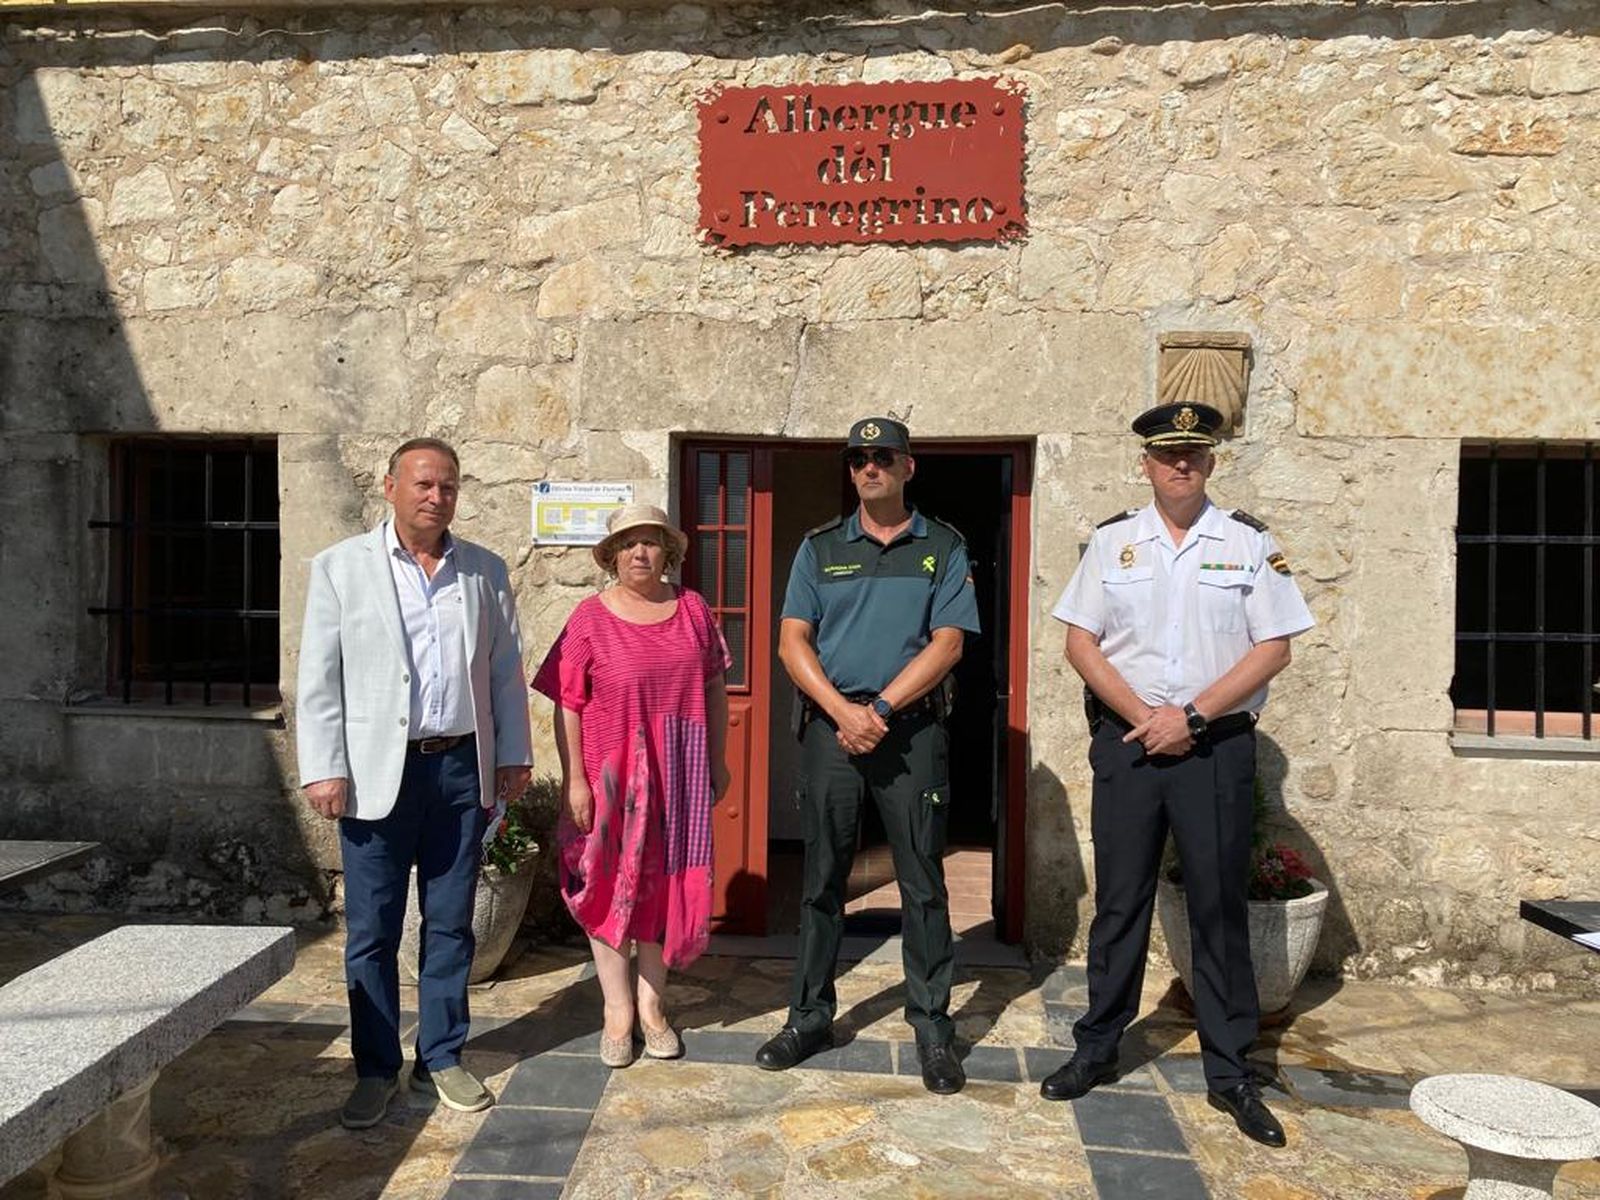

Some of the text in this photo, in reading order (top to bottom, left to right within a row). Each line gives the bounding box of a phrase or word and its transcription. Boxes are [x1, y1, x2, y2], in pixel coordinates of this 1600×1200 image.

[743, 94, 977, 139] Albergue
[817, 144, 893, 185] del
[739, 187, 994, 236] Peregrino
